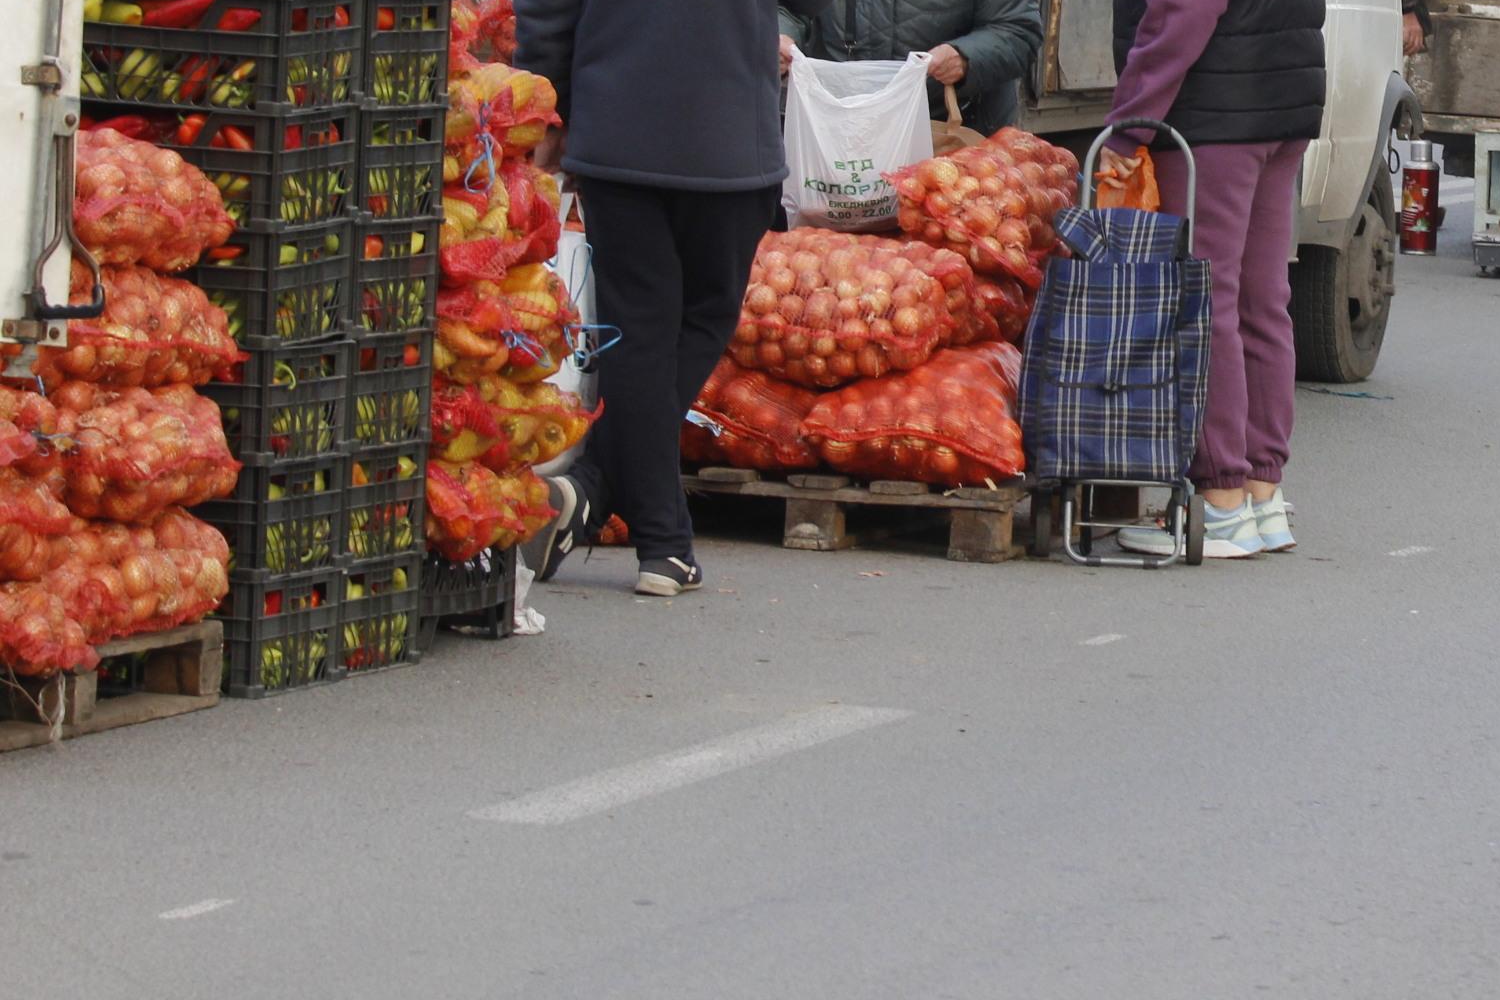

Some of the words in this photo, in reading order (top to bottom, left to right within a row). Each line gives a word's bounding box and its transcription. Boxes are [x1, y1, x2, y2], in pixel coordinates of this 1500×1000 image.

[804, 177, 892, 195] КОЛОРЛ
[828, 195, 890, 209] ЕЖЕДНЕВНО
[863, 206, 892, 218] 22.00
